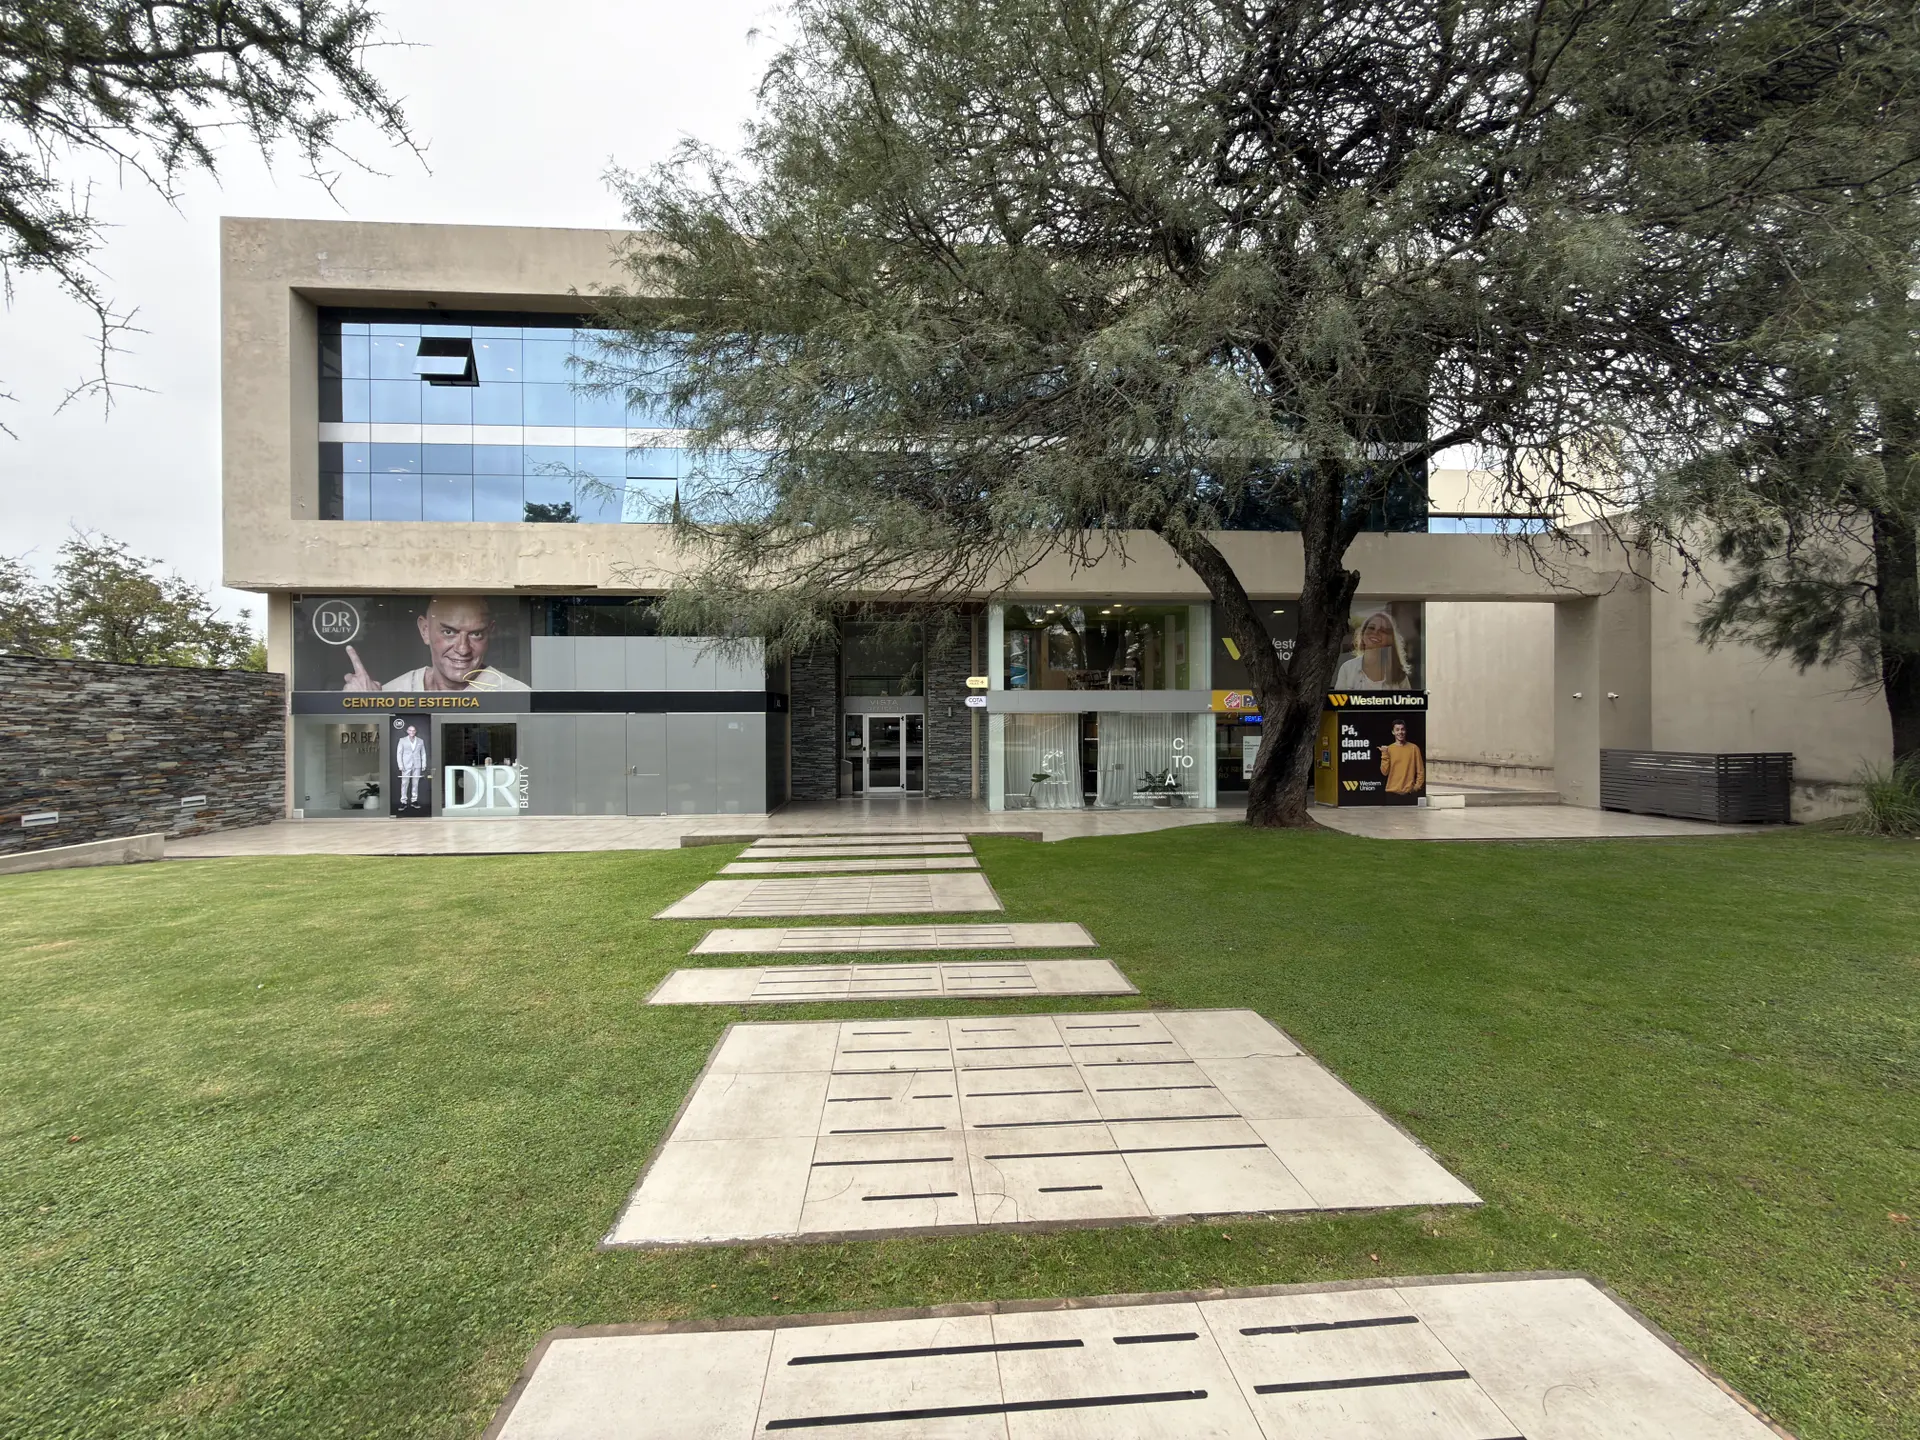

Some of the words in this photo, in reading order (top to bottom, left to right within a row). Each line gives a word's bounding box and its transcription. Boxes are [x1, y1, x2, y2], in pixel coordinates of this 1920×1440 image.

[322, 611, 351, 627] DR
[342, 697, 395, 708] CENTRO
[398, 697, 416, 708] DE
[418, 697, 480, 708] ESTETICA
[1349, 694, 1392, 705] Western
[1393, 694, 1424, 705] Union
[1341, 724, 1358, 736] Pá,
[1172, 737, 1185, 750] C
[1341, 737, 1370, 748] dame
[1172, 755, 1194, 768] TO
[1341, 749, 1371, 763] plata!
[1164, 773, 1176, 786] A
[444, 765, 518, 809] DR
[519, 764, 529, 809] BEAUTY
